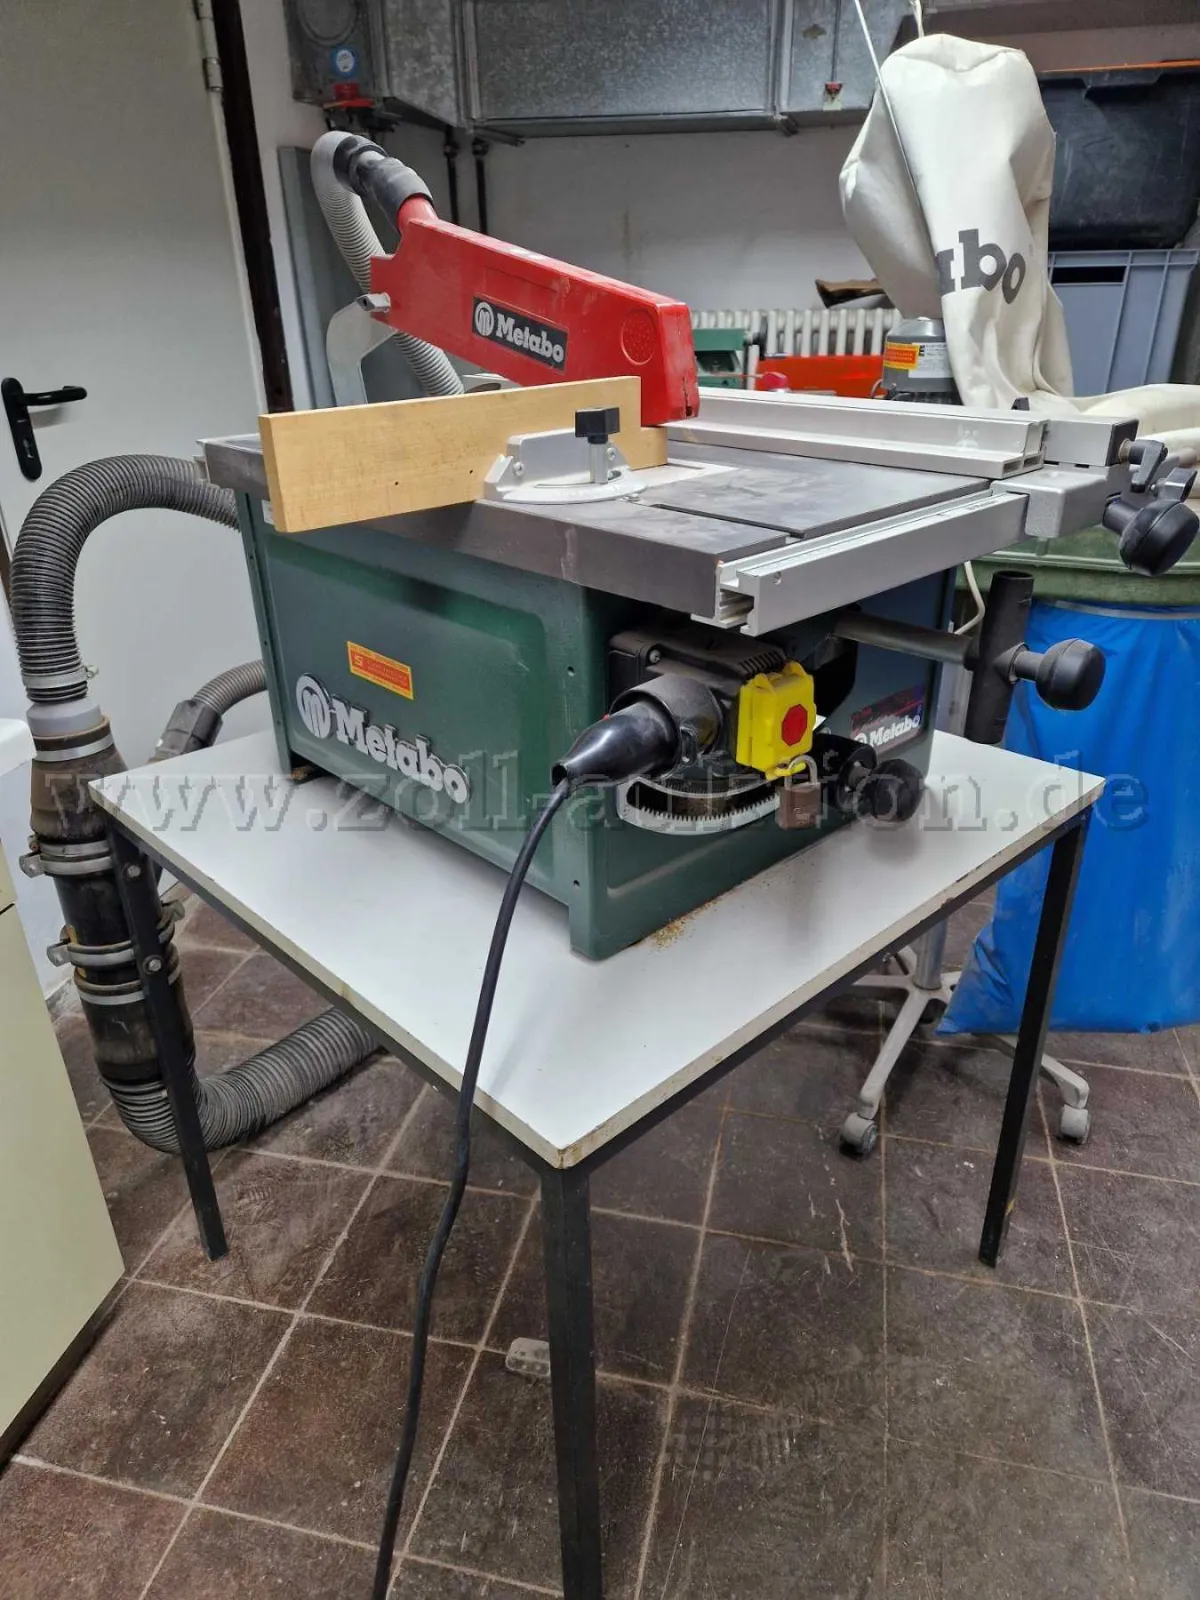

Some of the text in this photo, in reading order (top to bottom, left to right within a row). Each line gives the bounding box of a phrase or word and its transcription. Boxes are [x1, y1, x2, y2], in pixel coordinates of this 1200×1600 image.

[496, 312, 564, 363] Metabo
[332, 693, 470, 804] Metabo
[869, 714, 921, 748] Metabo
